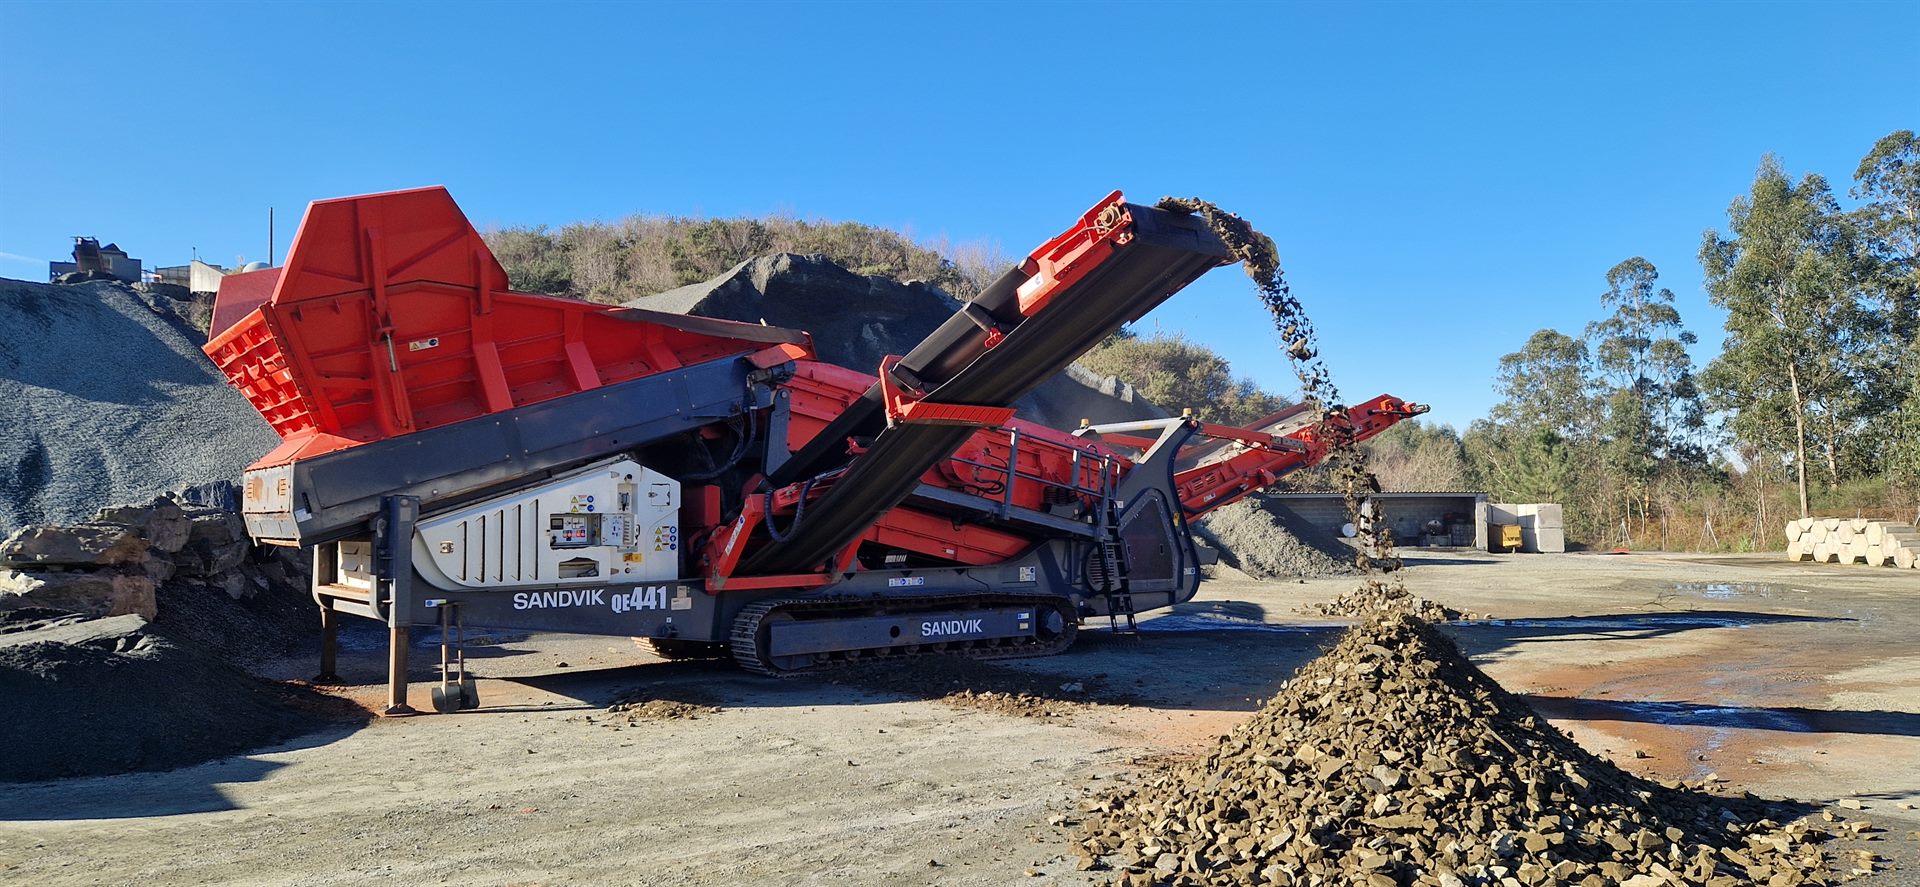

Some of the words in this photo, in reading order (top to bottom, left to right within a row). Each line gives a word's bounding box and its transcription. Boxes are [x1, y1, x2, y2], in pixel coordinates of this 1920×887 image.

[513, 589, 605, 610] SANDVIK
[611, 586, 667, 613] QE441
[922, 619, 982, 636] SANDVIK
